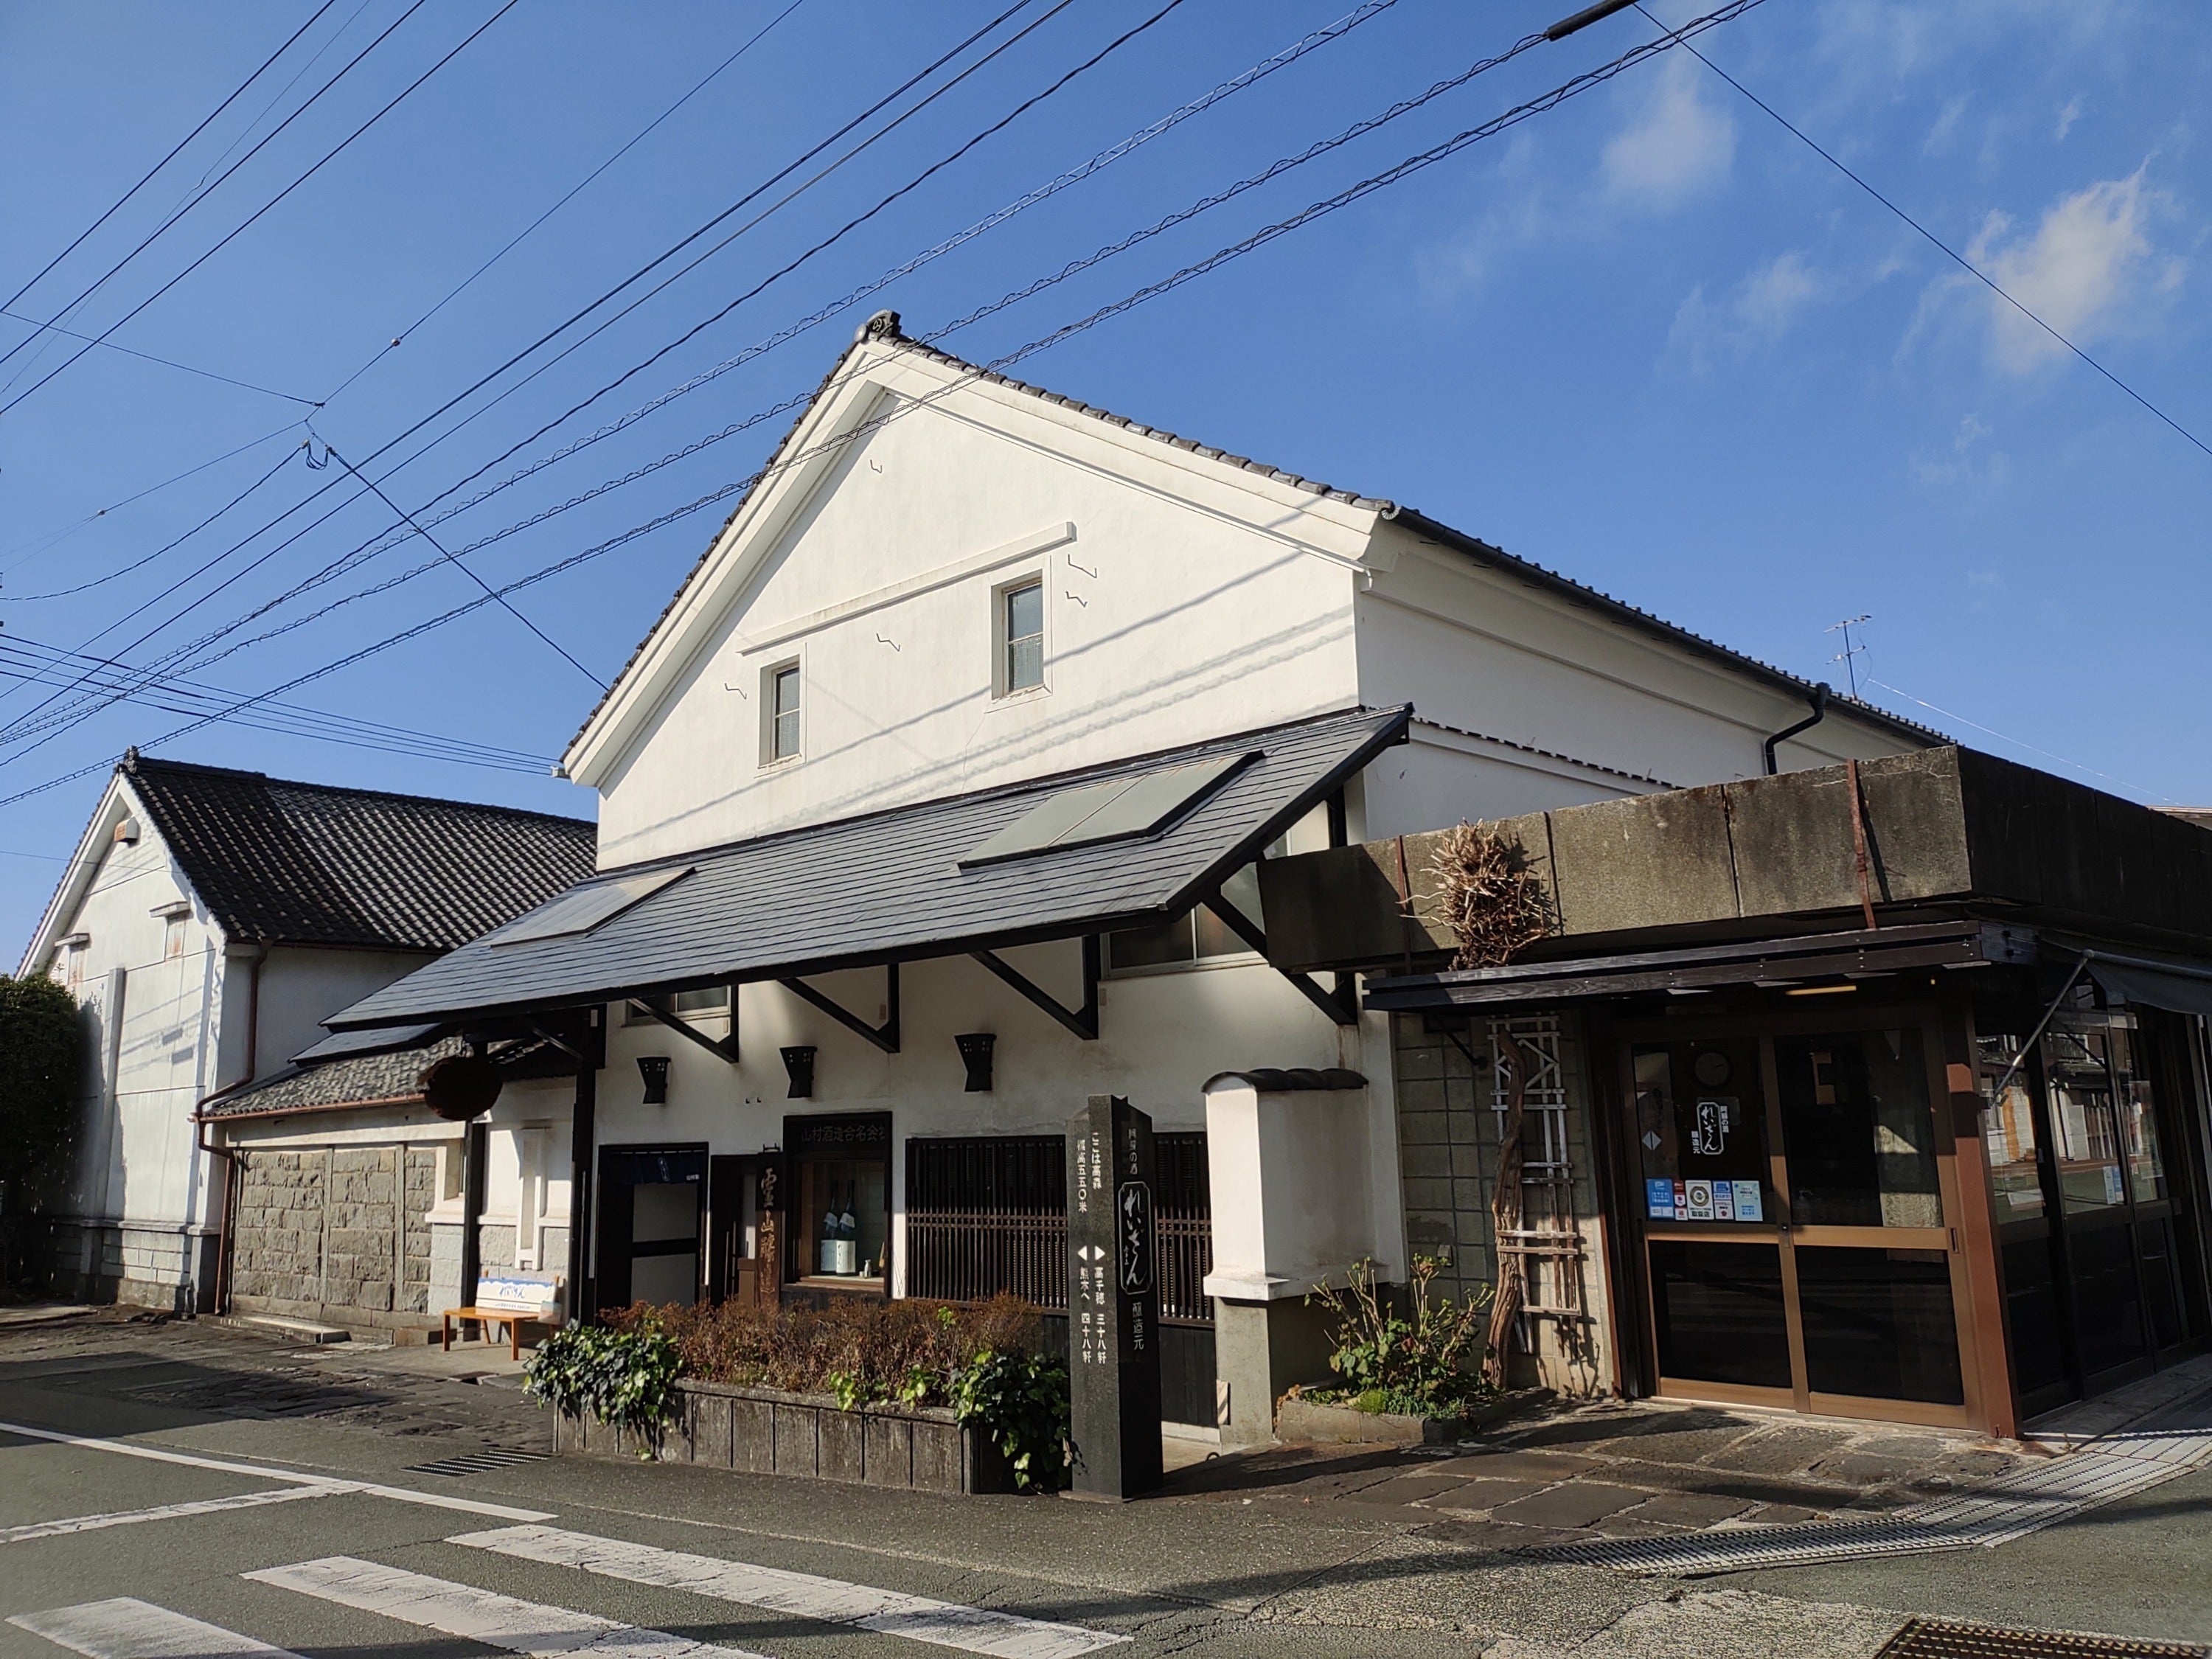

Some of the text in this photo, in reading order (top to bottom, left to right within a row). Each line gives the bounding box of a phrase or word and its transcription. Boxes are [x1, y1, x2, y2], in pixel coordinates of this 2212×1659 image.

[1091, 1132, 1102, 1190] ここは高森
[1133, 1301, 1144, 1350] 醸造元
